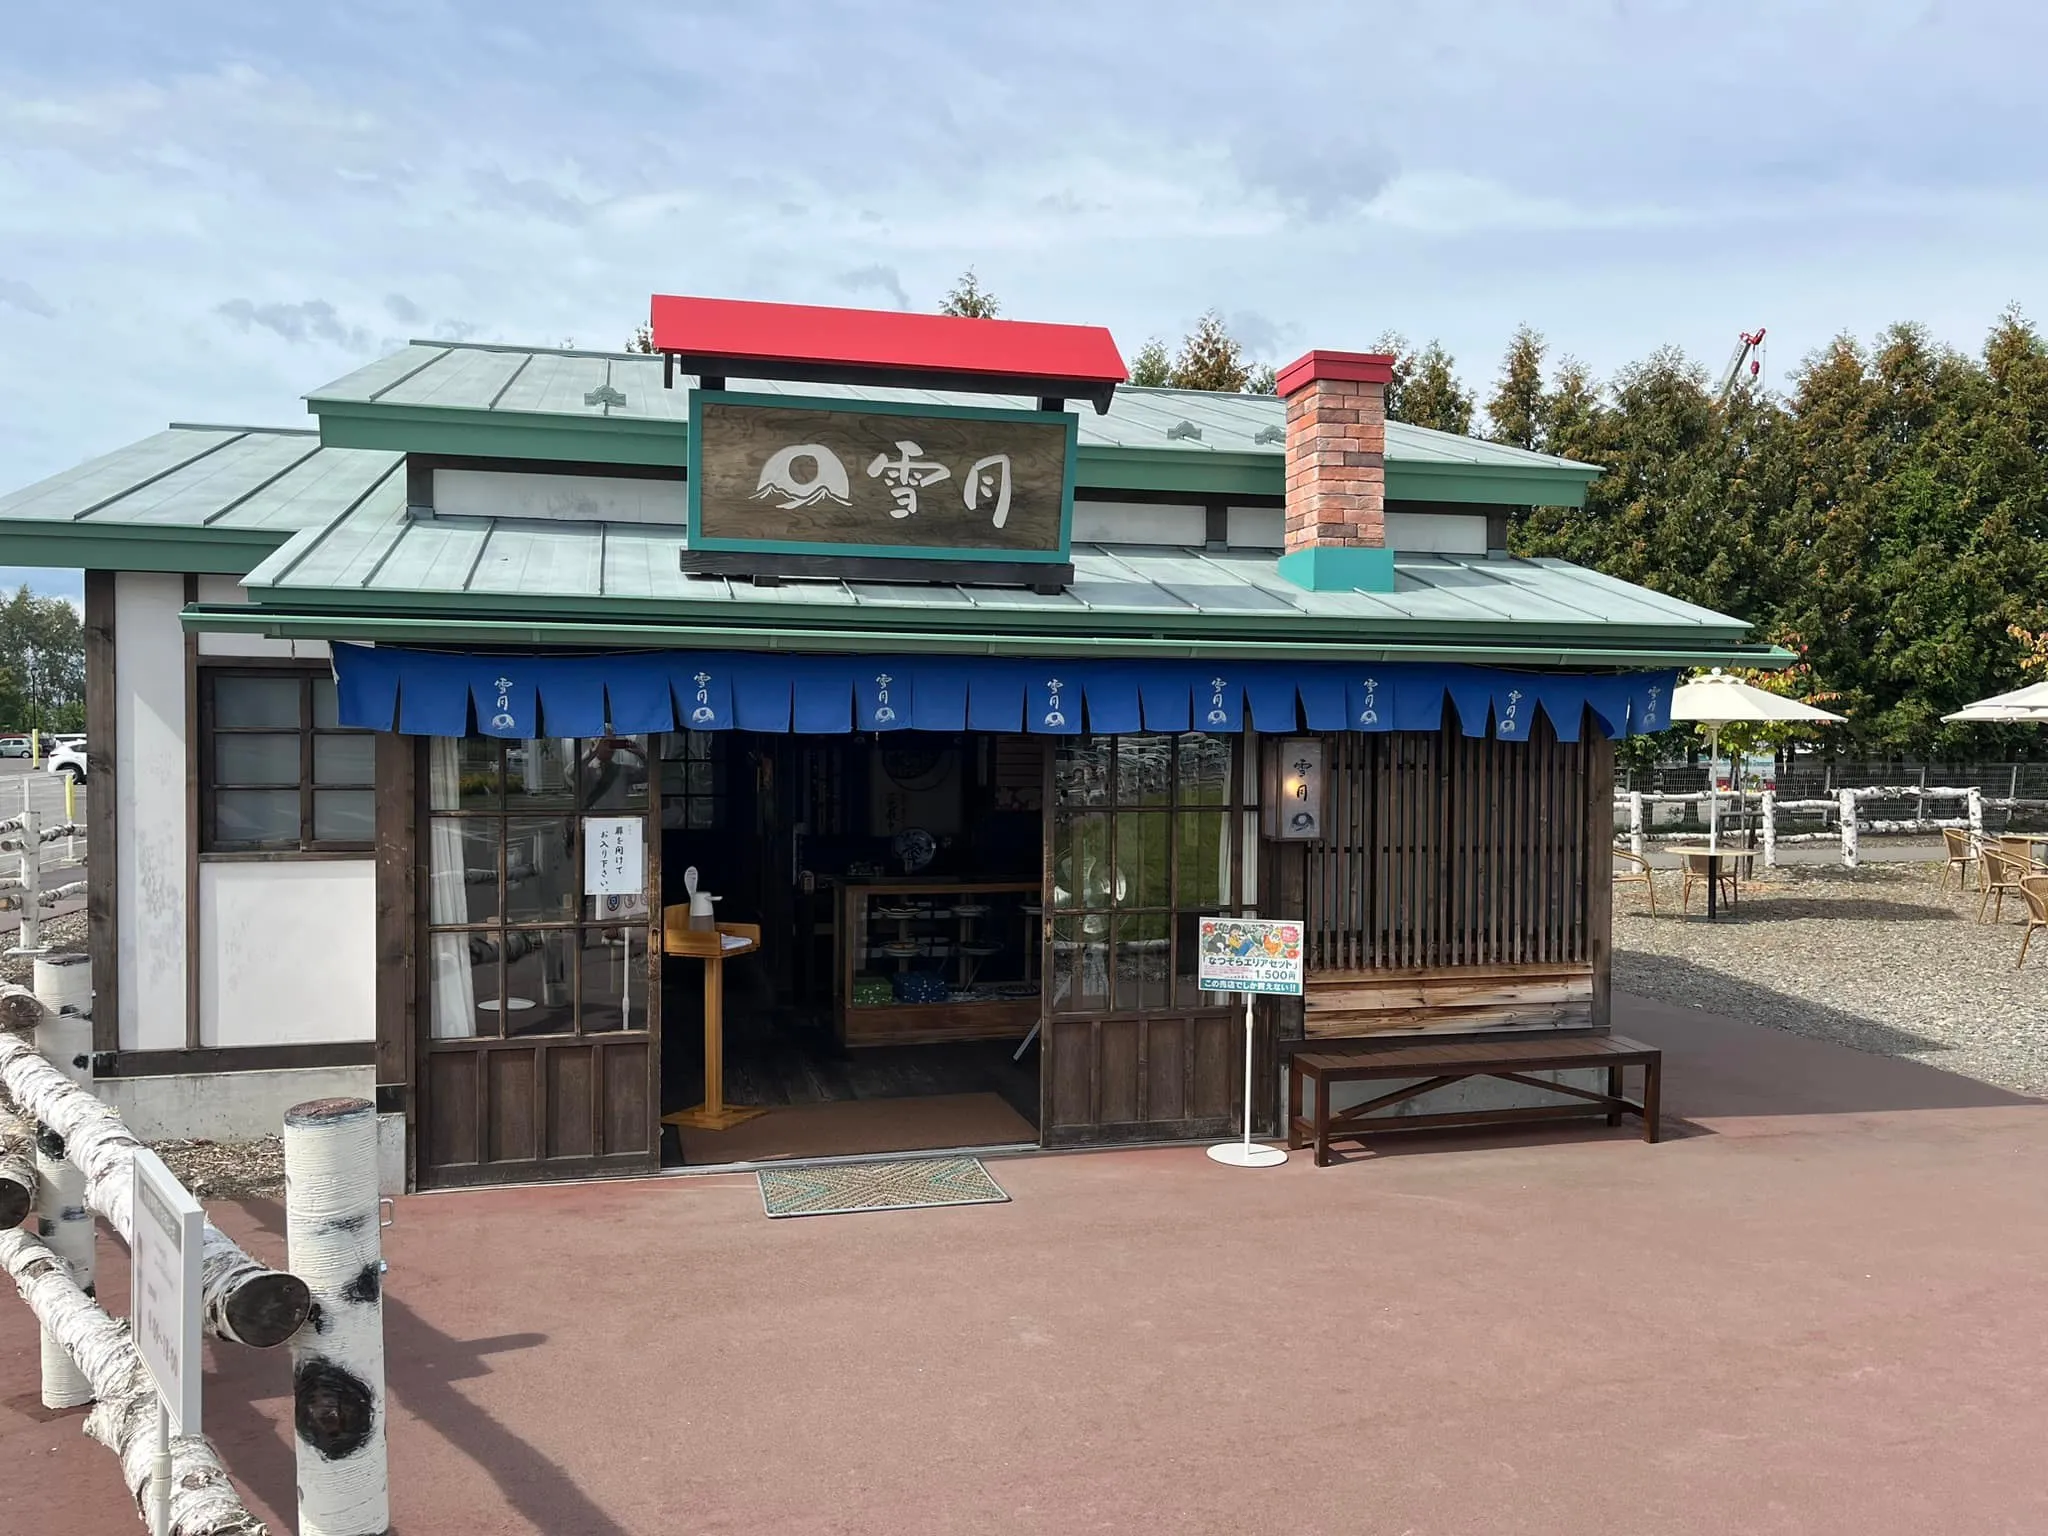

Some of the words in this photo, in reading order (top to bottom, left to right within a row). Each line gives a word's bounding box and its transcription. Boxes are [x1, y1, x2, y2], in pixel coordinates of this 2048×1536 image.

[866, 440, 1013, 529] 雪月
[494, 677, 513, 711] 雪月
[693, 671, 712, 704] 雪月
[875, 673, 893, 704] 雪月
[1047, 678, 1064, 709] 雪月
[1211, 677, 1227, 708] 雪月
[1363, 678, 1379, 708] 雪月
[1505, 689, 1523, 719] 雪月
[1293, 758, 1313, 802] 雪月
